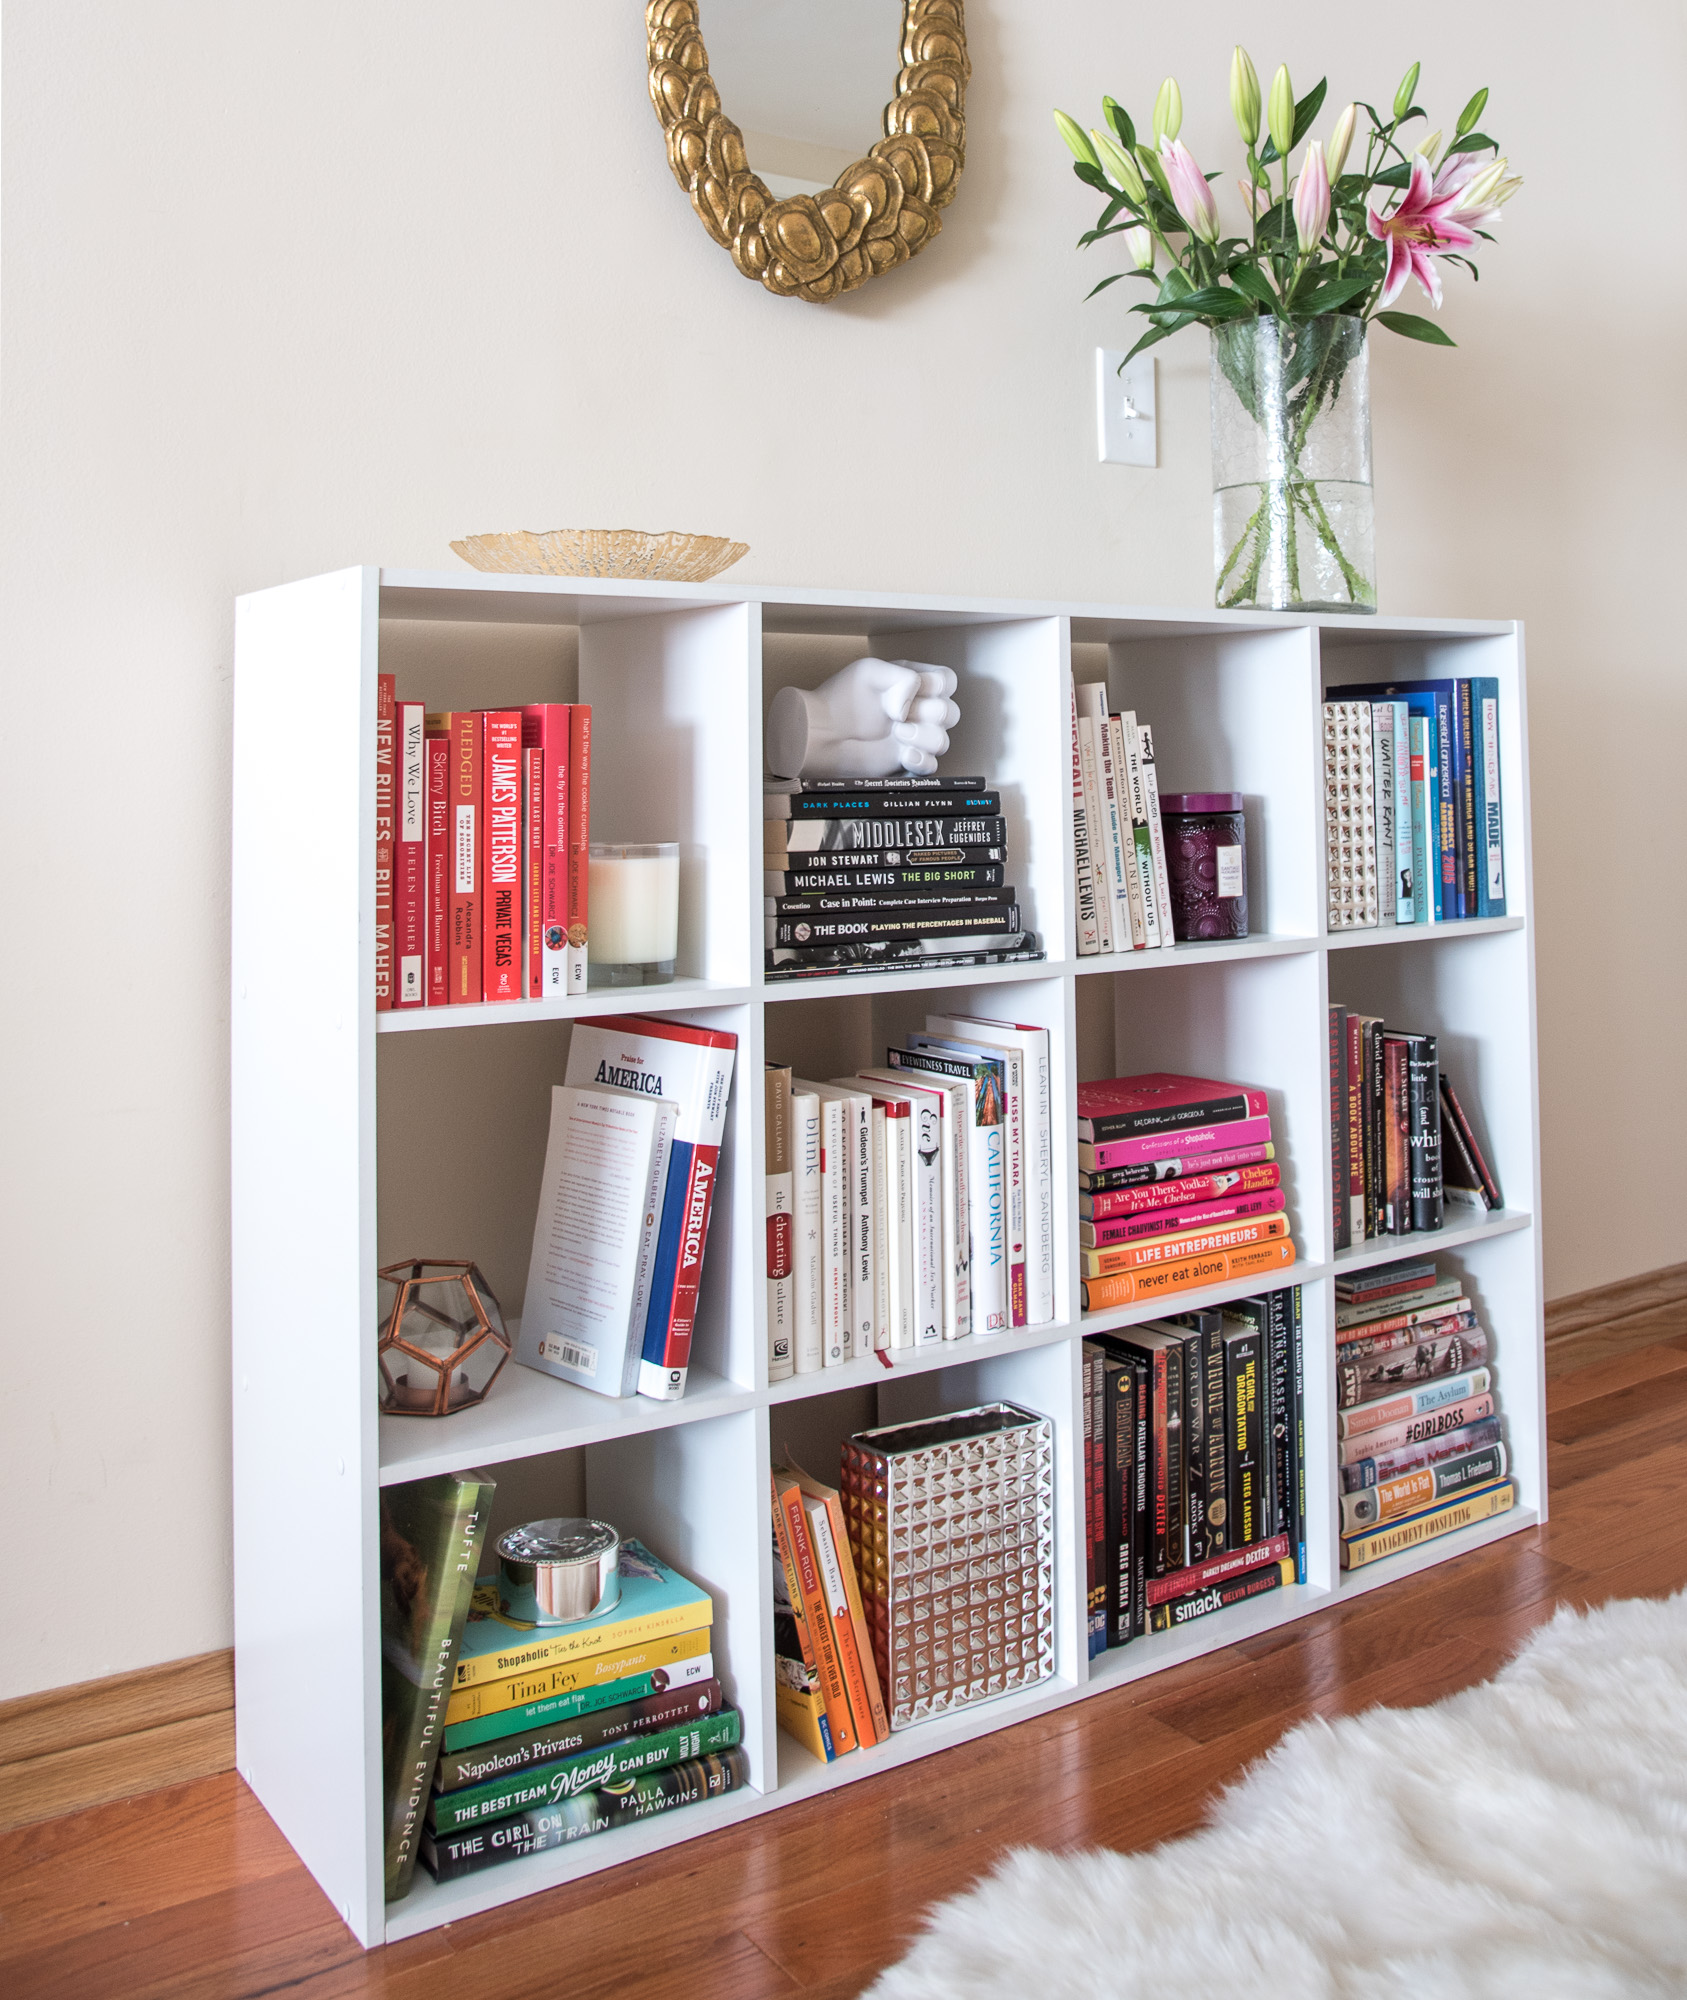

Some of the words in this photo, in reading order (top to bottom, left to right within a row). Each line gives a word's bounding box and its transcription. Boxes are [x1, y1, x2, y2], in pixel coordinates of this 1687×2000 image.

[407, 724, 420, 757] Why
[1101, 724, 1110, 757] Making
[407, 763, 419, 785] We
[431, 753, 446, 794] Skinny
[460, 720, 473, 796] PLEDGED
[1103, 760, 1112, 774] the
[1381, 739, 1392, 798] WAITER
[491, 754, 516, 802] JAMES
[557, 781, 565, 790] fly
[1105, 777, 1115, 799] Team
[1132, 775, 1142, 814] WORLD
[407, 791, 418, 824] Love
[433, 801, 446, 836] Bitch
[853, 821, 944, 848] MIDDLESEX
[950, 832, 991, 843] EUGENIDES
[954, 822, 986, 832] JEFFREY
[1382, 807, 1392, 850] RANT
[1487, 802, 1500, 848] MADE
[491, 807, 516, 883] PATTERSON
[1074, 809, 1091, 875] MICHAEL
[408, 847, 416, 892] HELEN
[808, 856, 827, 866] JON
[832, 855, 878, 865] STEWART
[902, 873, 920, 882] THE
[924, 872, 940, 881] BIG
[944, 871, 975, 880] SHORT
[1443, 855, 1454, 884] 2015
[795, 875, 851, 886] MICHAEL
[856, 874, 894, 885] LEWIS
[1142, 861, 1153, 909] WITHOUT
[495, 890, 512, 929] PRIVATE
[820, 899, 840, 908] Case
[842, 899, 849, 907] in
[851, 897, 876, 907] Point:
[1079, 877, 1095, 921] LEWIS
[407, 902, 416, 952] FISHER
[455, 907, 463, 945] Robbins
[465, 901, 474, 949] Alexandra
[814, 925, 836, 935] THE
[838, 923, 868, 934] BOOK
[1147, 913, 1154, 926] US
[495, 933, 512, 966] VEGAS
[621, 1054, 636, 1063] Praise
[899, 1054, 943, 1070] EYEWITNESS
[944, 1063, 971, 1077] TRAVEL
[595, 1060, 663, 1095] AMERICA
[775, 1082, 783, 1110] DAVID
[653, 1116, 667, 1166] ELIZABETH
[921, 1109, 937, 1141] Eve
[1012, 1129, 1019, 1145] MY
[805, 1118, 818, 1176] blink
[860, 1127, 869, 1165] Gideon's
[1012, 1150, 1020, 1187] TIARA
[1243, 1168, 1272, 1179] Chelsea
[1243, 1178, 1275, 1189] Handler
[649, 1171, 659, 1209] GILBERT
[776, 1192, 785, 1210] the
[858, 1167, 869, 1206] Trumpet
[987, 1132, 1003, 1266] CALIFORNIA
[1114, 1194, 1130, 1204] Are
[1133, 1188, 1149, 1200] You
[1153, 1184, 1179, 1197] There,
[1181, 1177, 1210, 1191] Vodka?
[1131, 1199, 1144, 1211] It's
[1146, 1198, 1161, 1208] Me,
[1164, 1192, 1195, 1204] Chelsea
[683, 1160, 713, 1268] AMERICA
[1102, 1228, 1127, 1241] FEMALE
[1128, 1220, 1163, 1235] CHAUVINIST
[1165, 1217, 1179, 1230] PIGS
[642, 1232, 651, 1251] EAT,
[773, 1216, 787, 1277] cheating
[859, 1214, 869, 1252] Anthony
[1136, 1248, 1161, 1263] LIFE
[1165, 1228, 1258, 1257] ENTREPRENEURS
[639, 1255, 648, 1280] PRAY,
[861, 1255, 870, 1281] Lewis
[1139, 1274, 1168, 1288] never
[1173, 1268, 1190, 1281] eat
[1194, 1262, 1222, 1277] alone
[636, 1285, 644, 1308] LOVE
[776, 1282, 786, 1325] culture
[1189, 1341, 1201, 1407] WORLD
[1419, 1394, 1435, 1407] The
[1437, 1385, 1466, 1402] Asylum
[1350, 1414, 1376, 1428] Simon
[1379, 1405, 1409, 1420] Doonan
[1405, 1409, 1464, 1443] #GIRLBOSS
[1137, 1421, 1146, 1461] PATELLAR
[1191, 1416, 1201, 1455] WAR
[1137, 1463, 1145, 1511] TENDONITIS
[1189, 1464, 1203, 1481] Z
[1242, 1472, 1251, 1498] STIEG
[1243, 1501, 1251, 1541] LARSSON
[1371, 1525, 1423, 1556] MANAGEMENT
[1426, 1508, 1470, 1536] CONSULTING
[456, 1511, 479, 1572] TUFTE
[789, 1505, 806, 1551] FRANK
[800, 1556, 814, 1589] RICH
[819, 1520, 833, 1566] Sebastian
[828, 1569, 838, 1593] Barry
[1119, 1543, 1129, 1569] GREG
[1245, 1547, 1269, 1565] DEXTER
[814, 1600, 822, 1612] THE
[1118, 1574, 1128, 1608] RUCKA
[1176, 1589, 1222, 1622] smack
[1223, 1585, 1245, 1603] MELVIN
[1247, 1576, 1276, 1594] BURGESS
[815, 1614, 829, 1644] GREATEST
[497, 1647, 549, 1669] Shopaholic
[595, 1654, 646, 1675] Bossypants
[687, 1666, 701, 1676] ECW
[821, 1645, 832, 1664] STORY
[508, 1680, 546, 1702] Tina
[551, 1671, 579, 1696] Fey
[826, 1665, 837, 1681] EVER
[419, 1639, 452, 1749] BEAUTIFUL
[526, 1707, 536, 1716] let
[537, 1703, 557, 1714] them
[558, 1700, 570, 1708] eat
[571, 1694, 585, 1704] flax
[829, 1682, 841, 1699] SOLD
[602, 1723, 629, 1737] TONY
[633, 1705, 689, 1728] PERROTTET
[823, 1729, 832, 1750] COMICS
[457, 1744, 530, 1780] Napoleon's
[532, 1733, 582, 1758] Privates
[455, 1809, 479, 1823] THE
[481, 1795, 512, 1814] BEST
[514, 1786, 546, 1805] TEAM
[548, 1754, 616, 1803] Money
[619, 1758, 644, 1771] CAN
[646, 1748, 669, 1763] BUY
[620, 1787, 664, 1808] PAULA
[396, 1761, 427, 1863] EVIDENCE
[635, 1789, 698, 1816] HAWKINS
[449, 1837, 483, 1859] THE
[492, 1825, 534, 1847] GIRL
[539, 1814, 562, 1830] ON
[513, 1837, 546, 1855] THE
[557, 1817, 609, 1842] TRAIN
